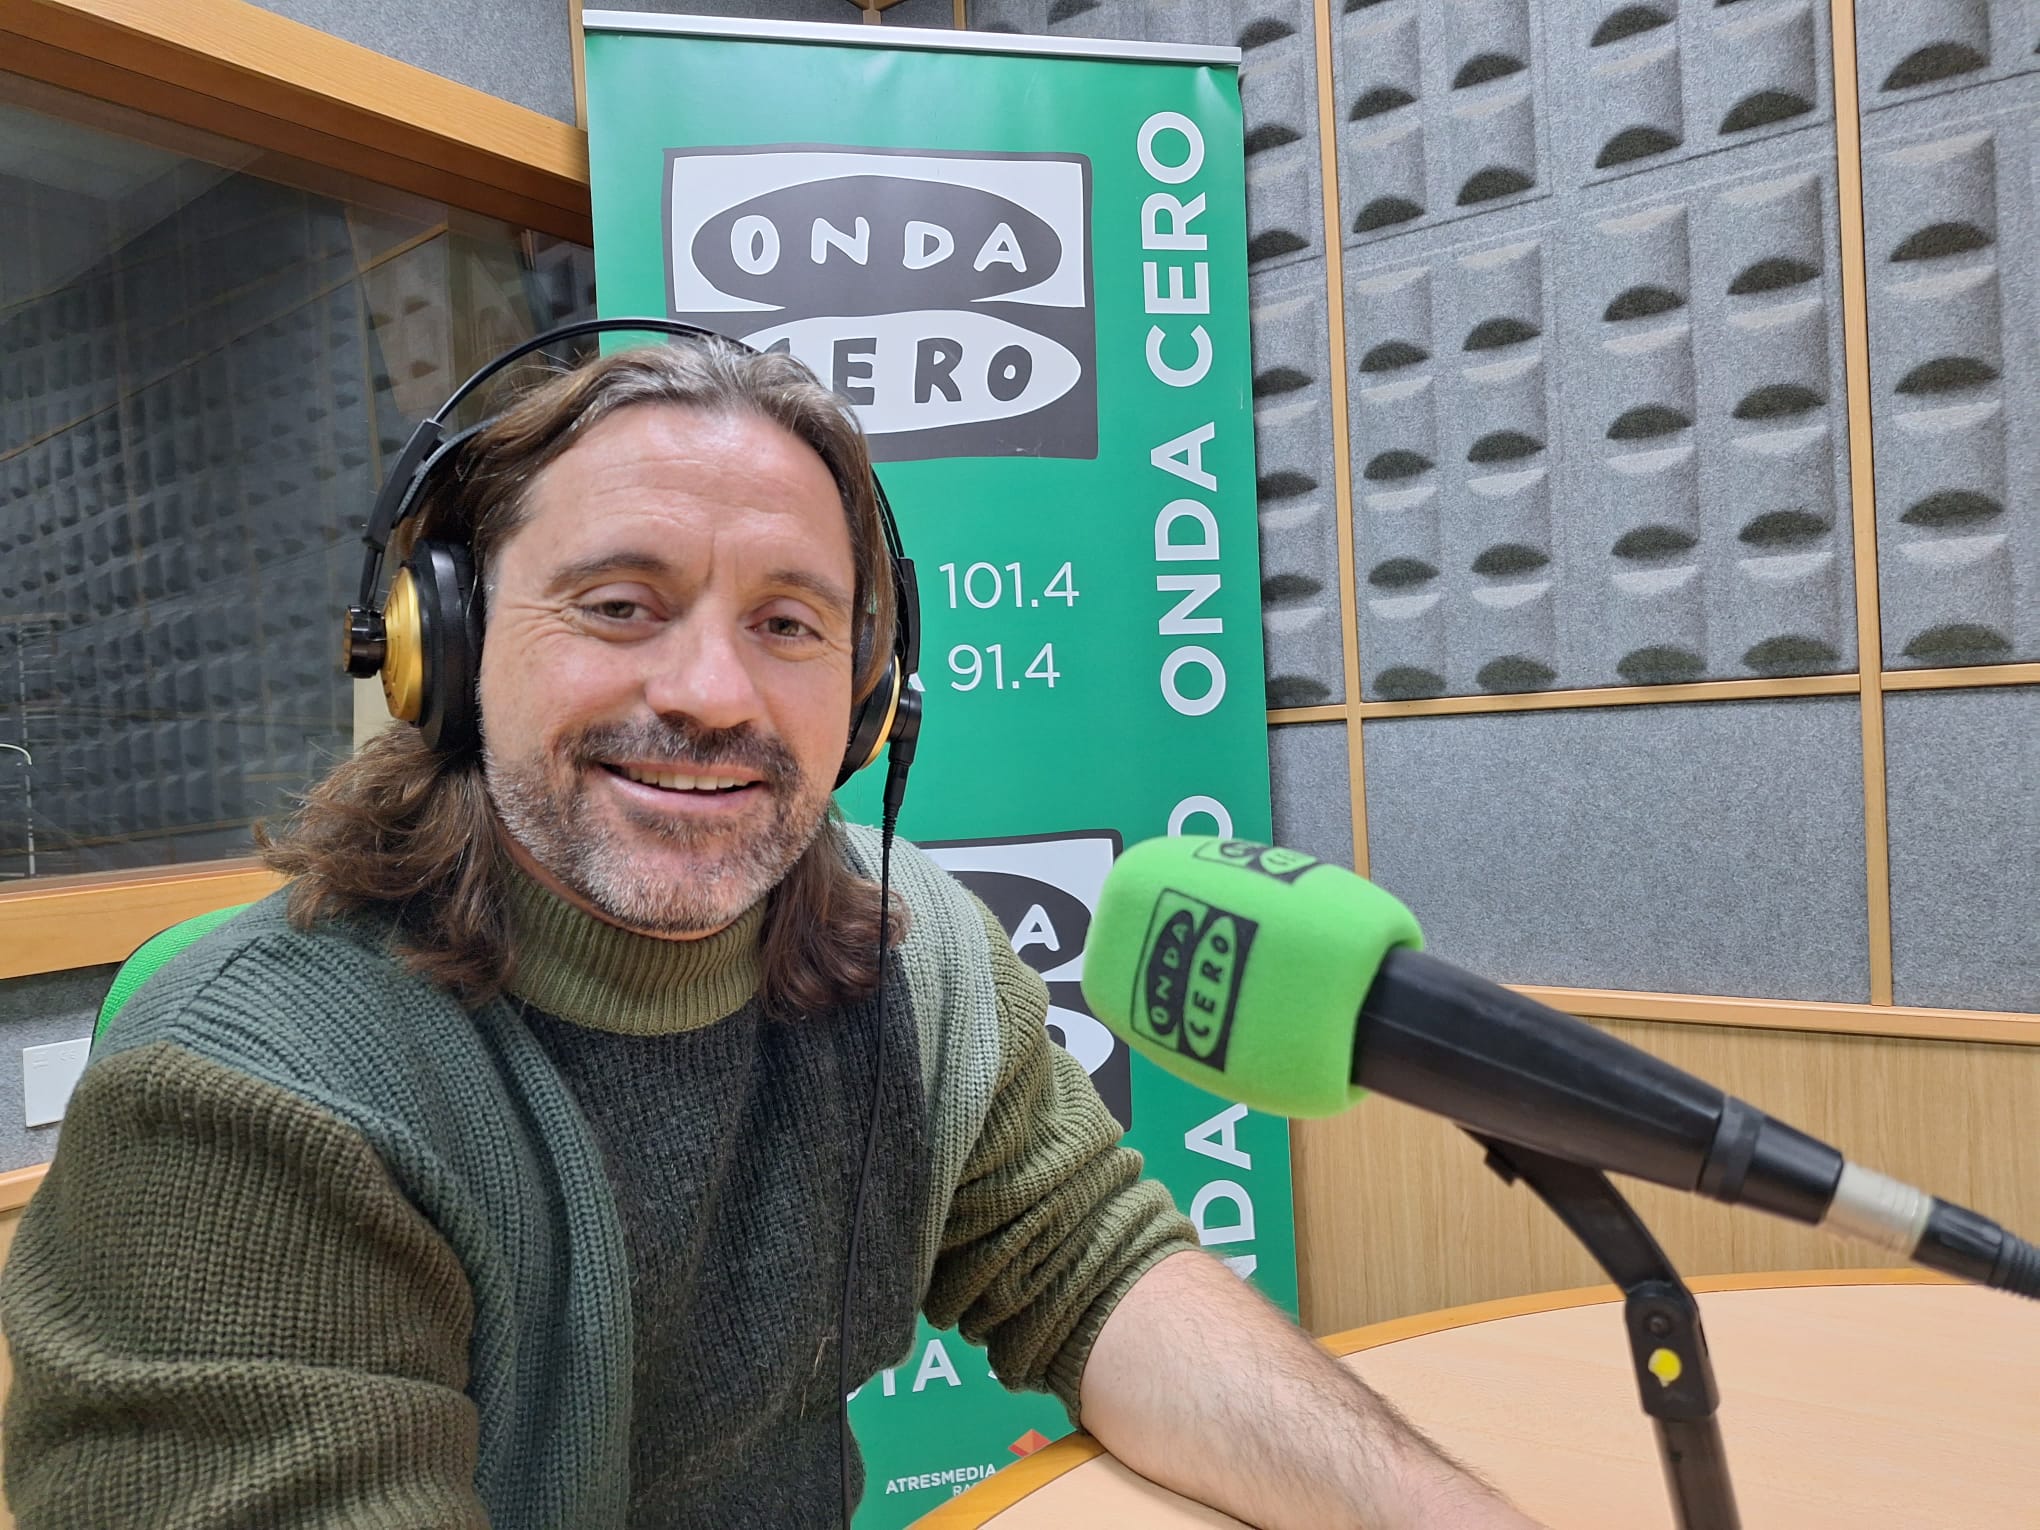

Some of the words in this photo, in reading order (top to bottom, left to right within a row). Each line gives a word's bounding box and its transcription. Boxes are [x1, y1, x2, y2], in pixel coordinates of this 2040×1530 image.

[730, 215, 1027, 275] ONDA
[1137, 111, 1213, 387] CERO
[762, 337, 1032, 405] ERO
[939, 562, 1080, 609] 101.4
[1150, 421, 1226, 716] ONDA
[948, 643, 1061, 691] 91.4
[1150, 922, 1189, 1025] ONDA
[1189, 935, 1229, 1037] CERO
[885, 1463, 996, 1494] ATRESMEDIA
